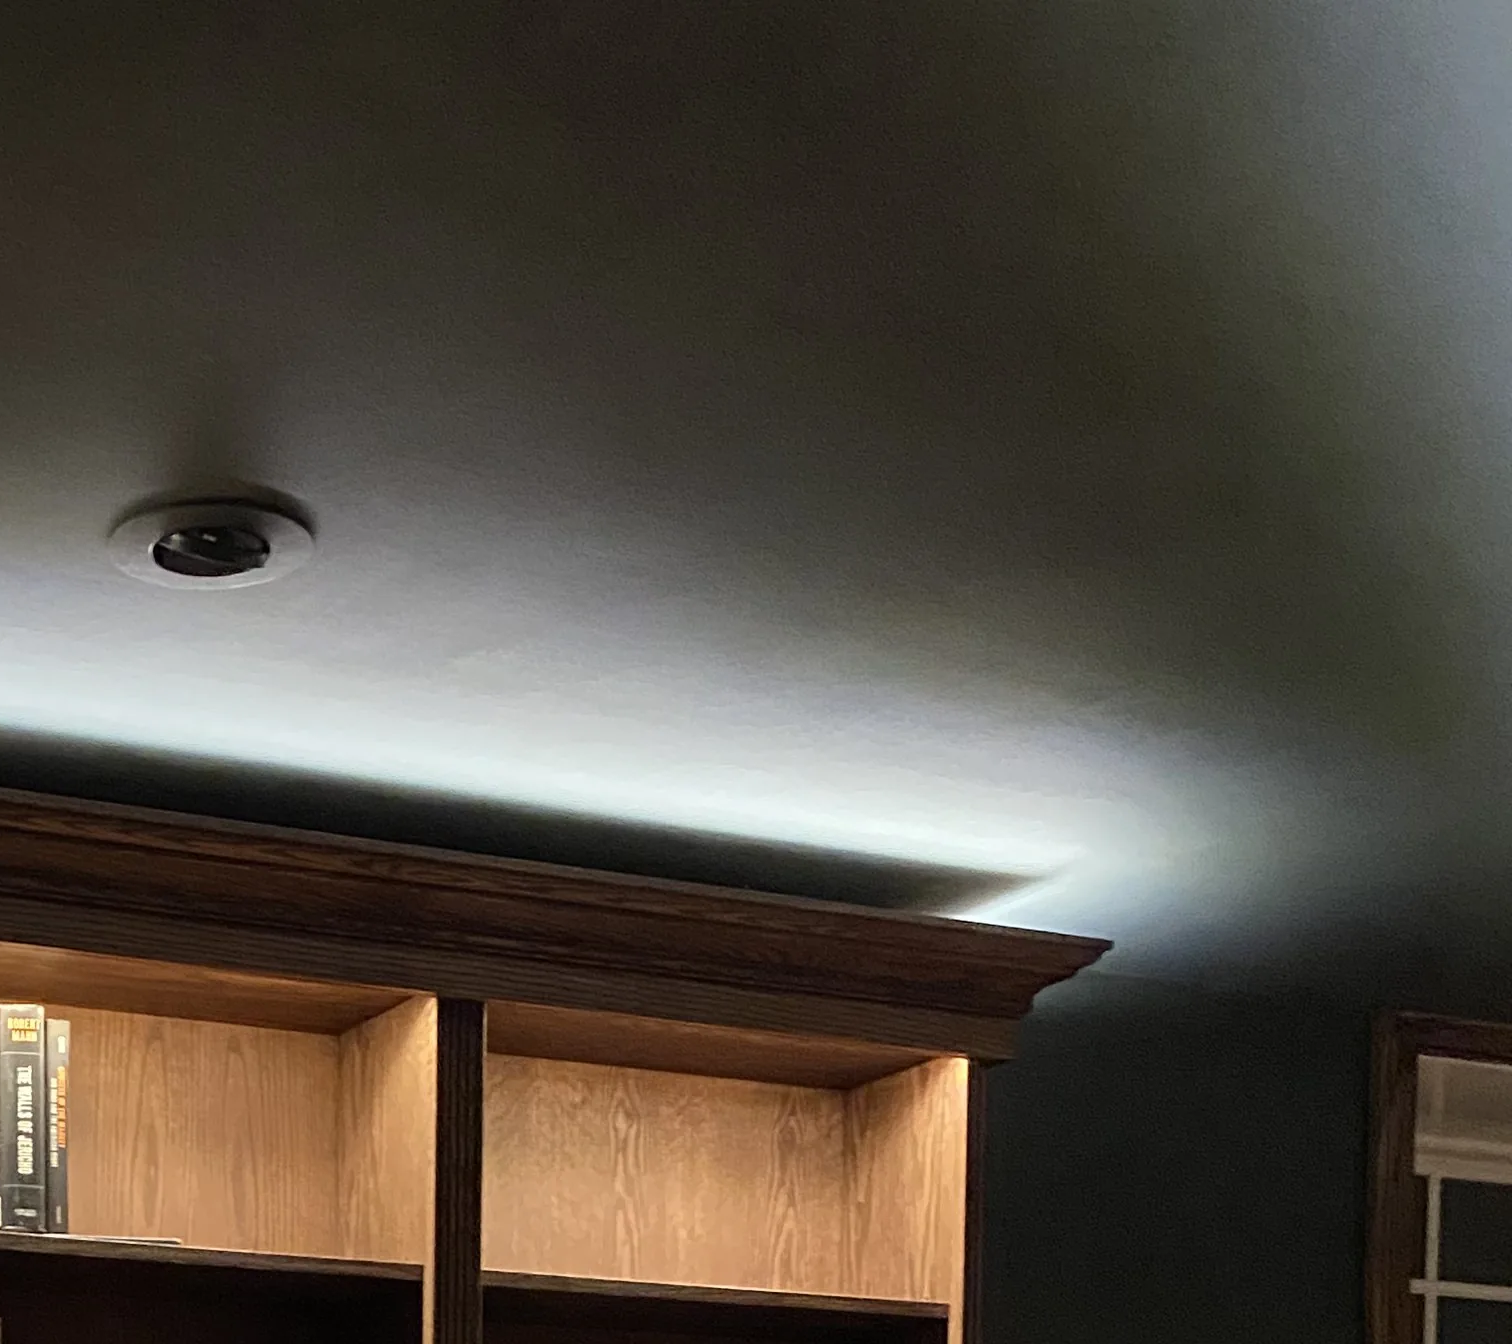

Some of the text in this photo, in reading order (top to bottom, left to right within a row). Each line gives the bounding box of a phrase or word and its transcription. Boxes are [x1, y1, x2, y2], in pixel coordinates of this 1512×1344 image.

[17, 1066, 34, 1174] THE WALLS OF JERICHO
